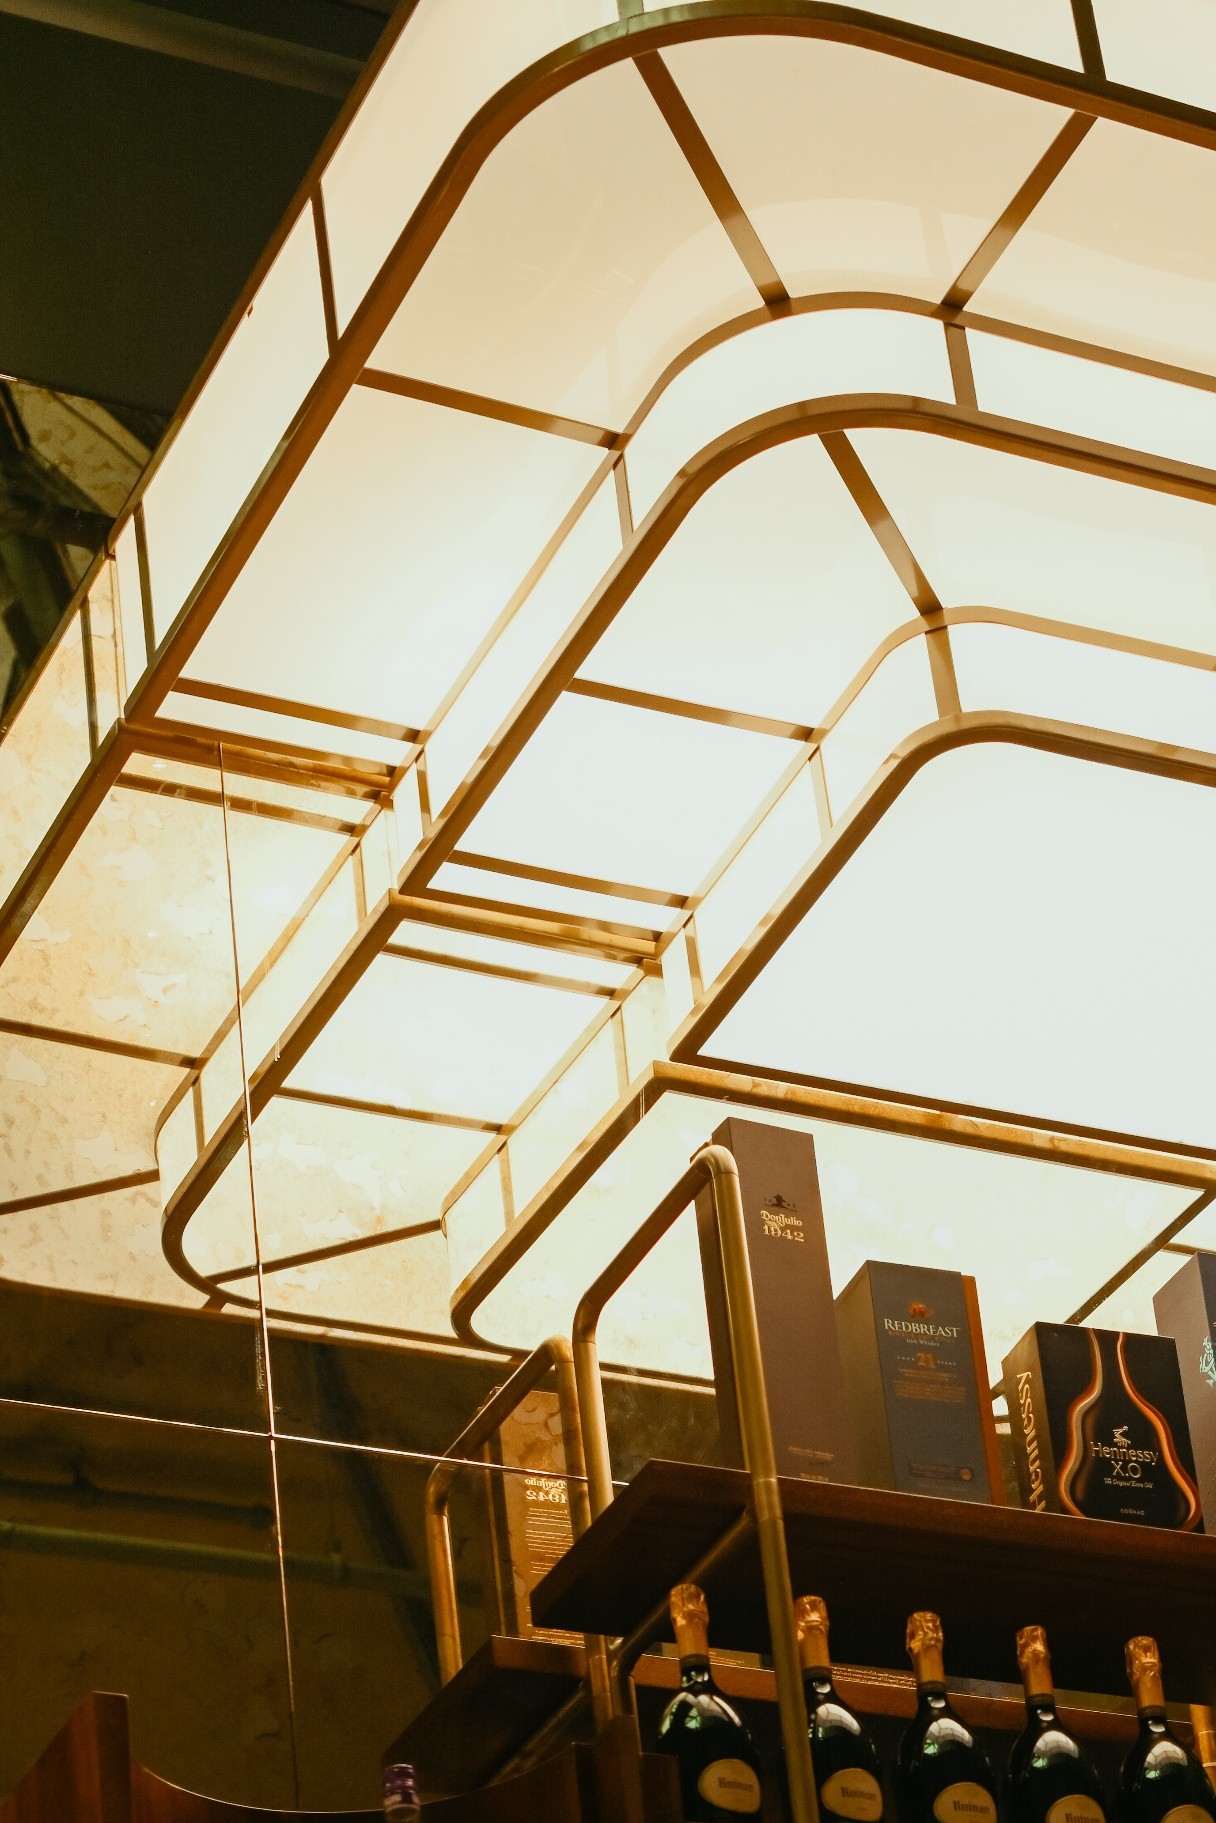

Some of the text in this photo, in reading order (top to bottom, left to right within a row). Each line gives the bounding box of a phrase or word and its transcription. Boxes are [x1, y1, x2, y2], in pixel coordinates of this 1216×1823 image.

[883, 1318, 961, 1338] REDBREAST
[1016, 1371, 1046, 1512] Hennessy
[1090, 1442, 1159, 1466] Hennessy
[1112, 1461, 1142, 1478] X.O
